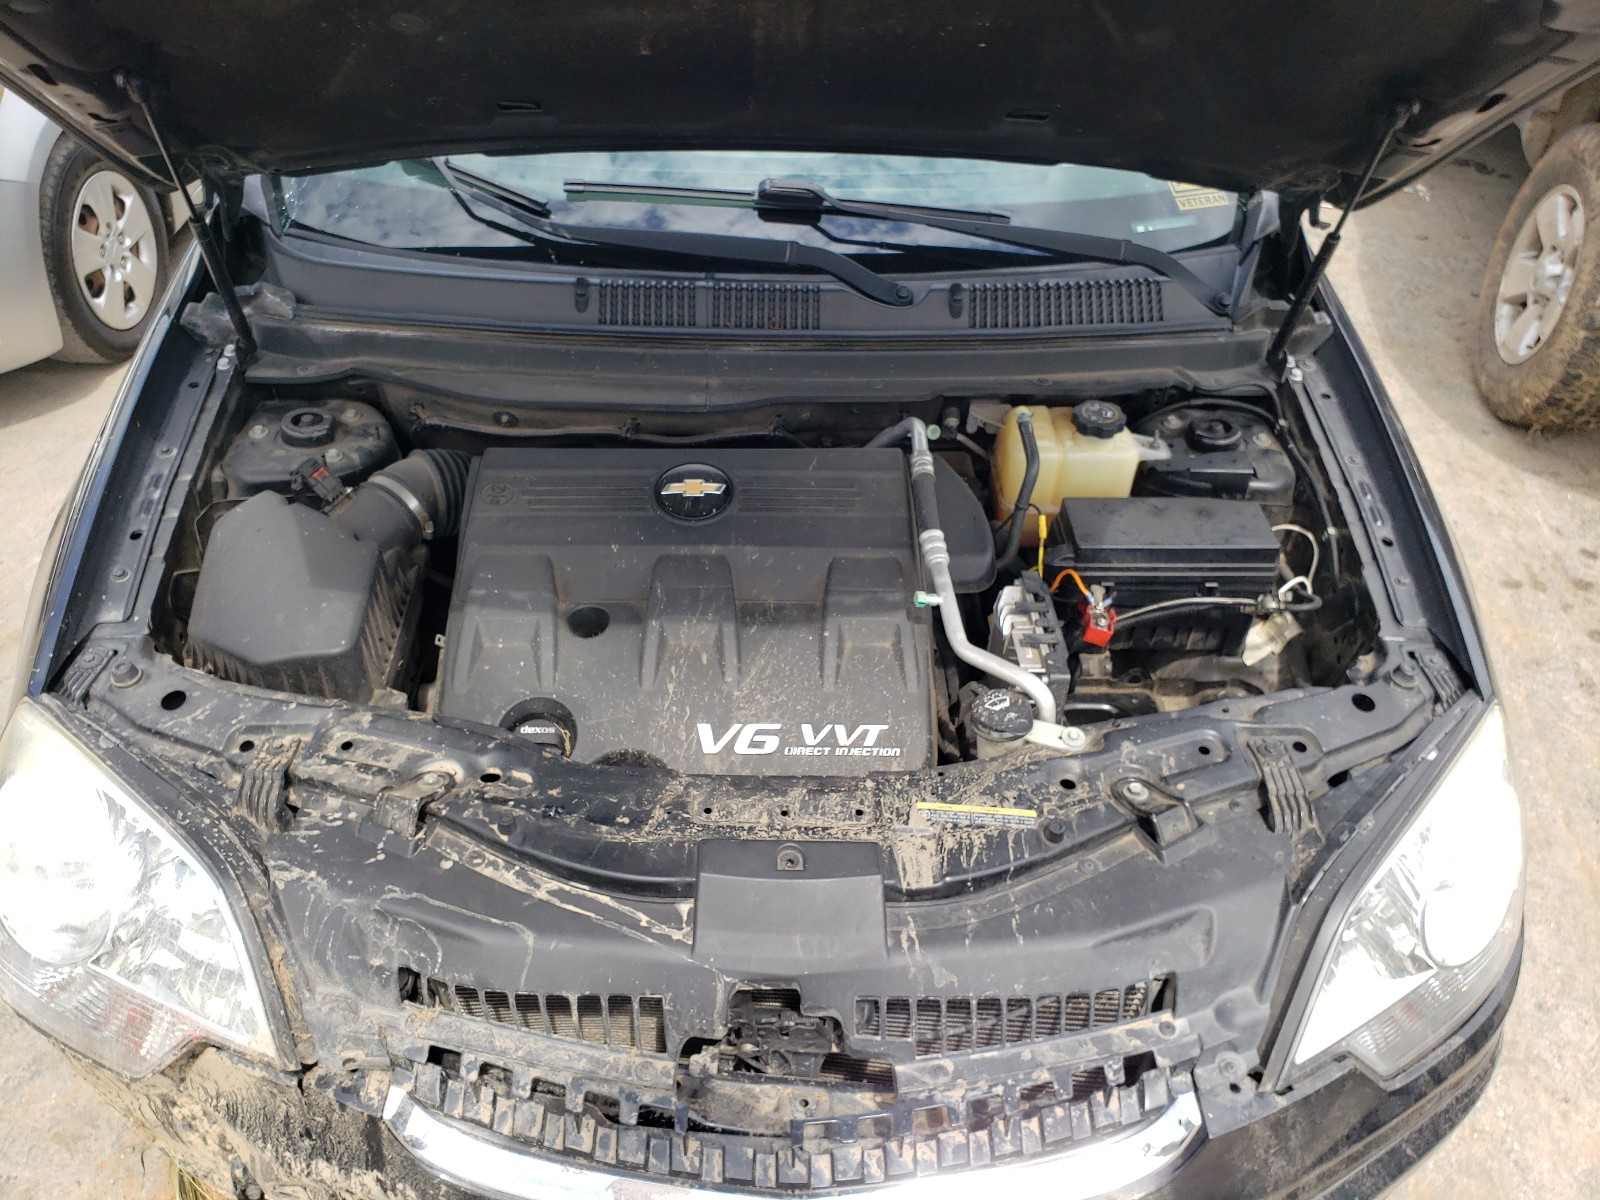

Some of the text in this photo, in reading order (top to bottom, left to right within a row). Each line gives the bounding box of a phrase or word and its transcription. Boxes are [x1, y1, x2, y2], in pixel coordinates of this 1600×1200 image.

[1178, 195, 1227, 208] VETERAN
[520, 725, 556, 734] dexos
[697, 722, 890, 755] V6 VVT
[784, 747, 901, 757] DIRECT INJECTION
